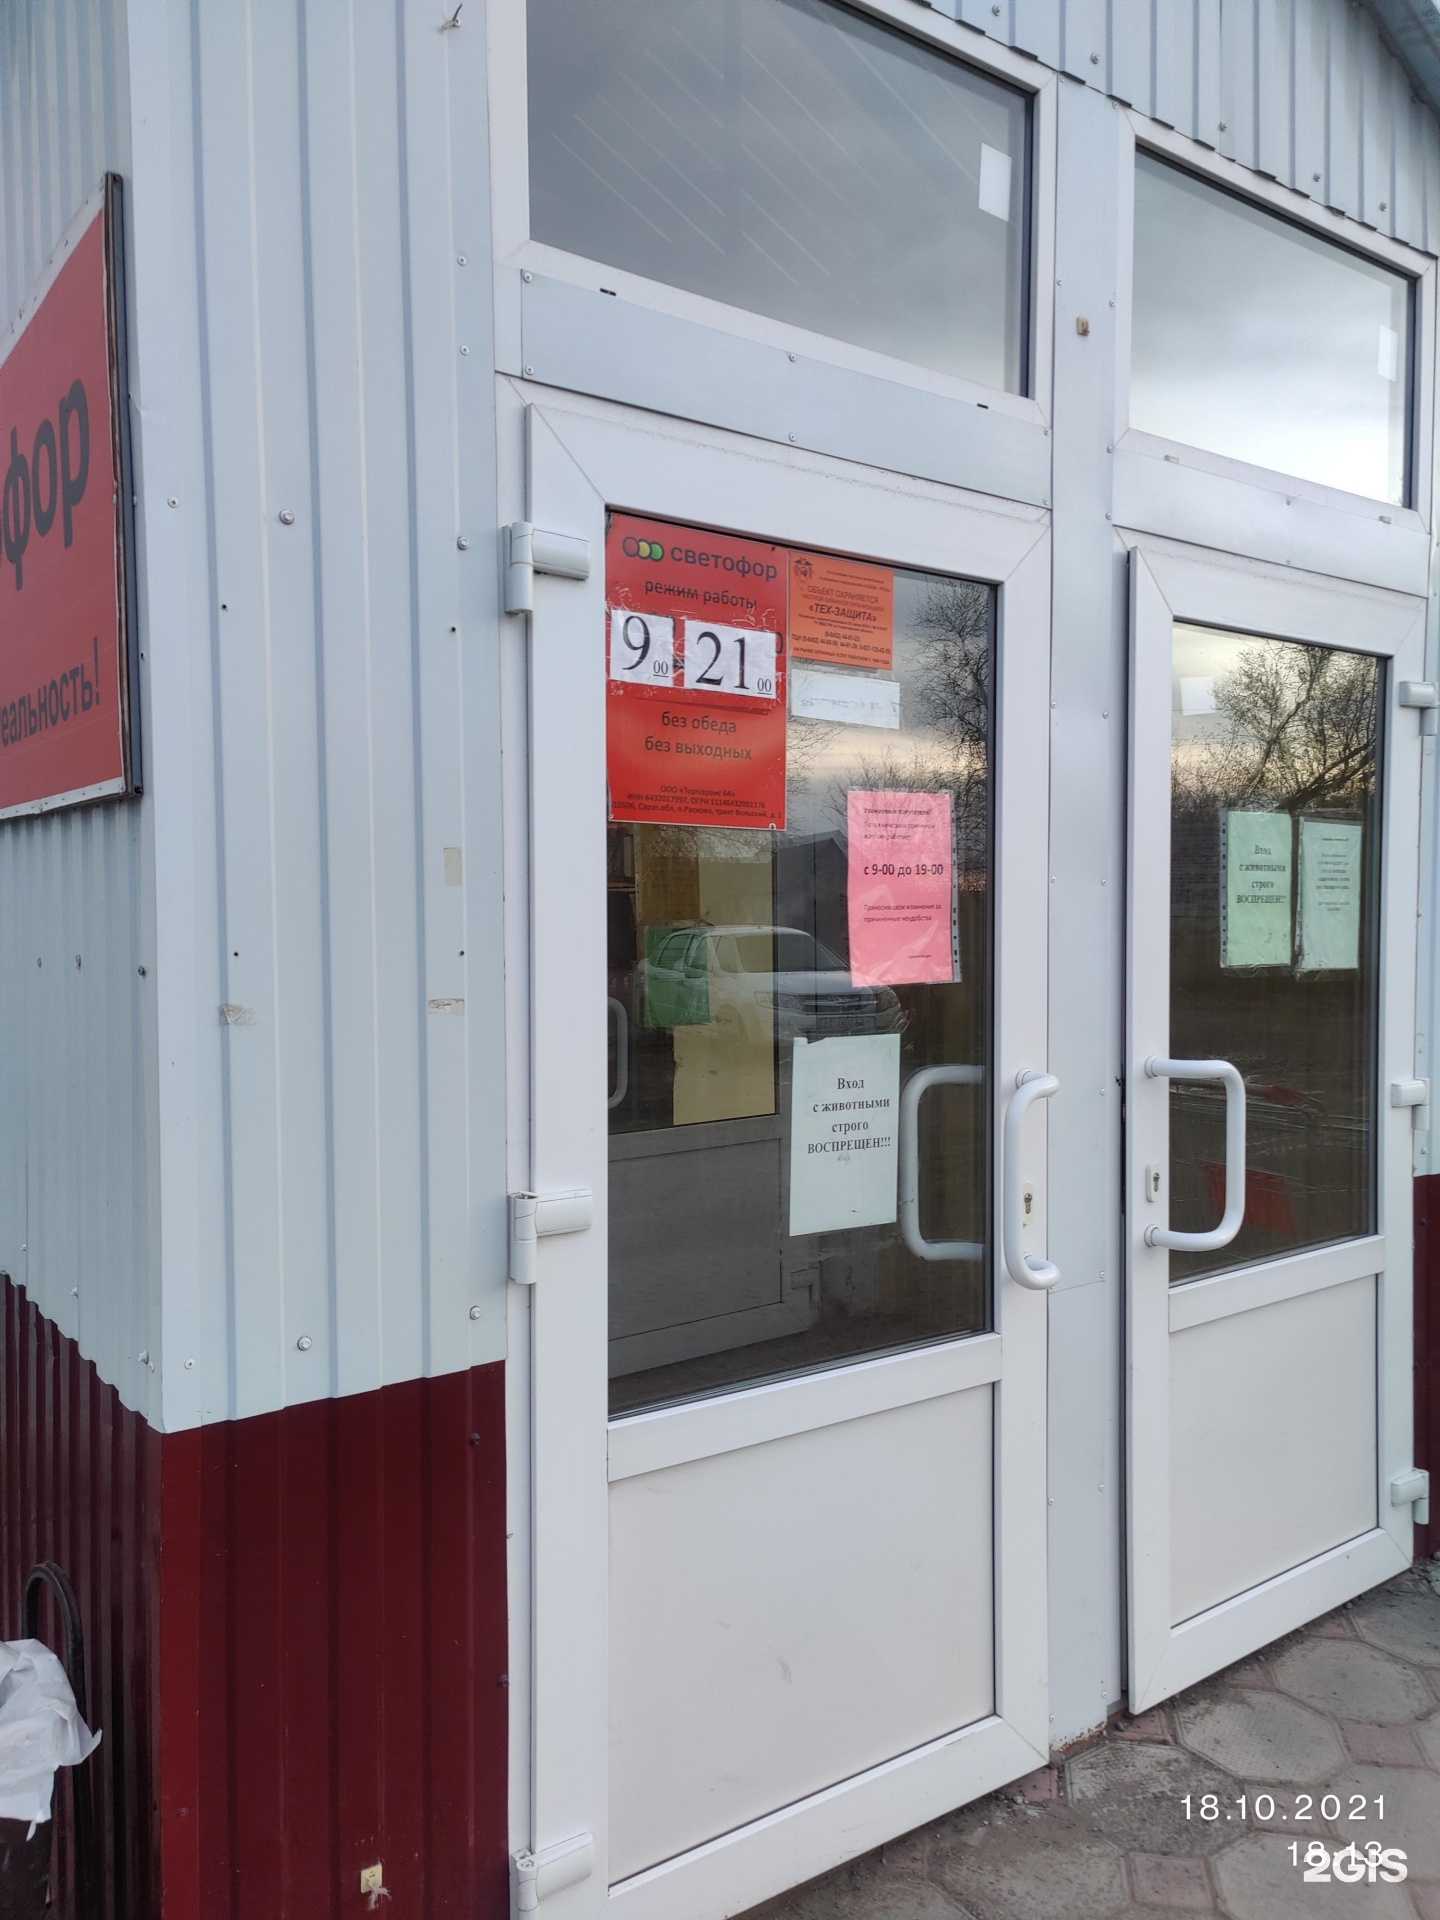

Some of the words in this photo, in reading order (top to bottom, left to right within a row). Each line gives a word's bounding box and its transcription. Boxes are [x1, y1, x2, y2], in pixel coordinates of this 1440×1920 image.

[670, 547, 777, 581] светофор
[645, 581, 699, 599] режим
[703, 591, 757, 609] работы
[809, 603, 877, 622] «ТЕХ-ЗАЩИТА»
[622, 615, 651, 670] 9
[653, 660, 669, 677] 00
[695, 631, 750, 689] 21
[757, 677, 773, 695] 00
[662, 711, 687, 728] без
[692, 716, 737, 735] обеда
[645, 736, 671, 753] без
[675, 743, 752, 761] выходных
[871, 864, 896, 876] 9-00
[897, 866, 912, 878] до
[915, 864, 944, 876] 19-00
[837, 1078, 865, 1090] Вход
[812, 1104, 819, 1112] с
[821, 1098, 890, 1112] животными
[831, 1121, 869, 1135] строго
[807, 1137, 891, 1154] ВОСПРЕЩЕН!!!
